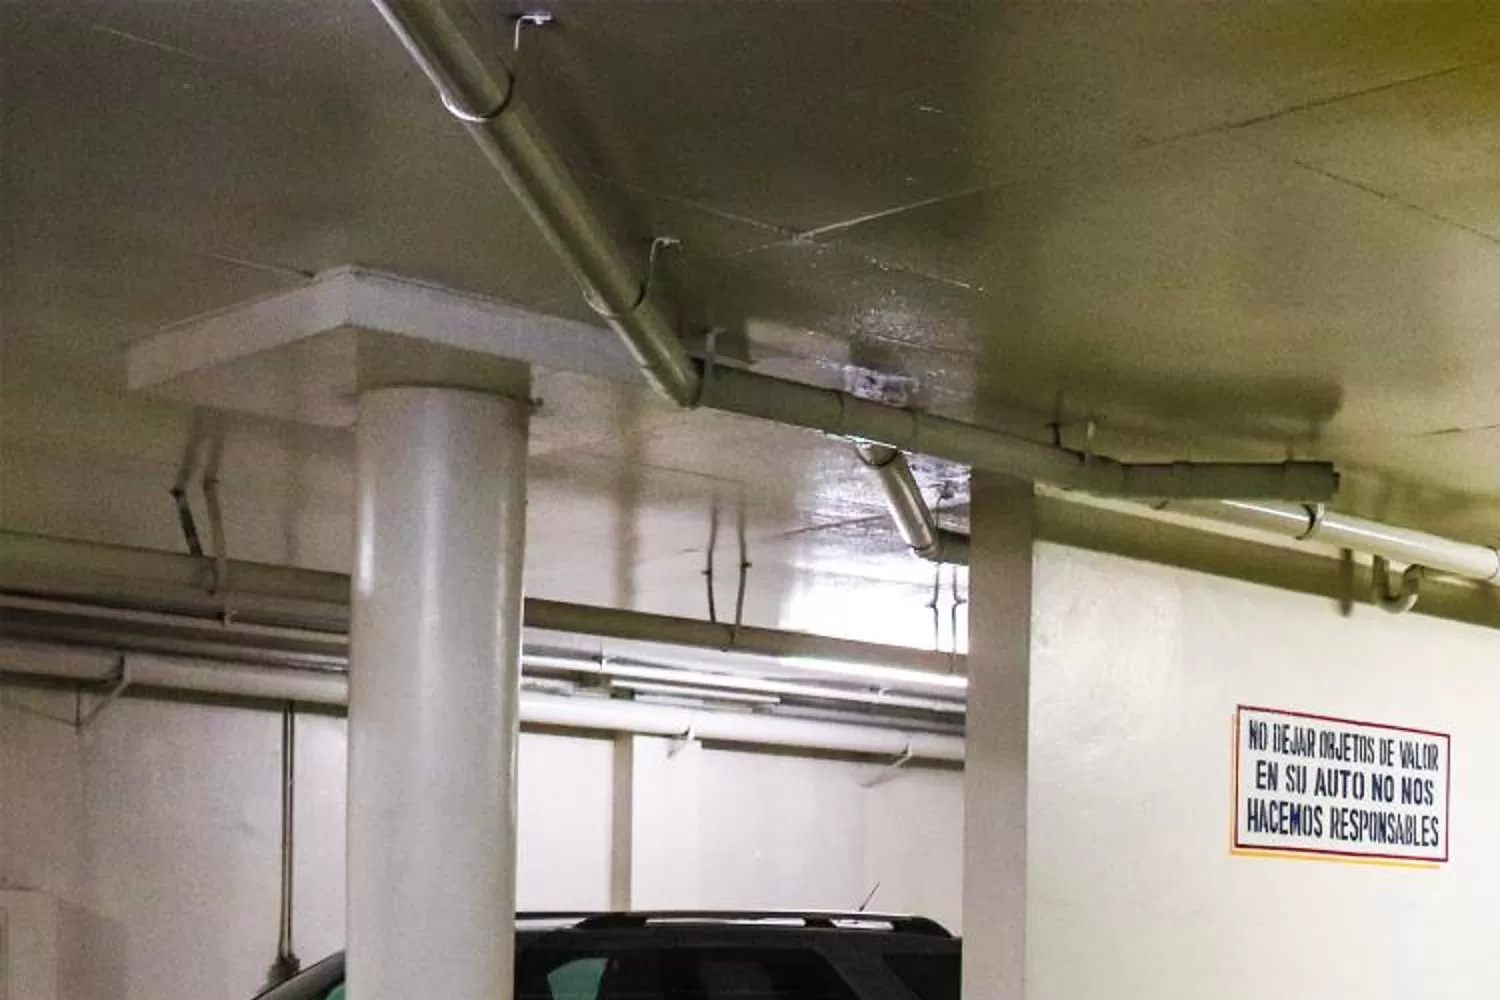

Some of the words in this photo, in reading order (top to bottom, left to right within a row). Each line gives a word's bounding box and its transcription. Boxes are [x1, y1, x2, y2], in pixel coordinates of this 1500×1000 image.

[1248, 719, 1267, 751] NO
[1273, 722, 1316, 758] DEJAR
[1319, 729, 1375, 766] OBJETOS
[1379, 736, 1395, 767] DE
[1399, 739, 1439, 772] VALOR
[1256, 759, 1279, 791] EN
[1285, 763, 1307, 795] SU
[1313, 767, 1365, 801] AUTO
[1371, 772, 1395, 803] NO
[1401, 776, 1434, 807] NOS
[1247, 797, 1323, 839] HACEMOS
[1329, 806, 1439, 847] RESPONSABLES
